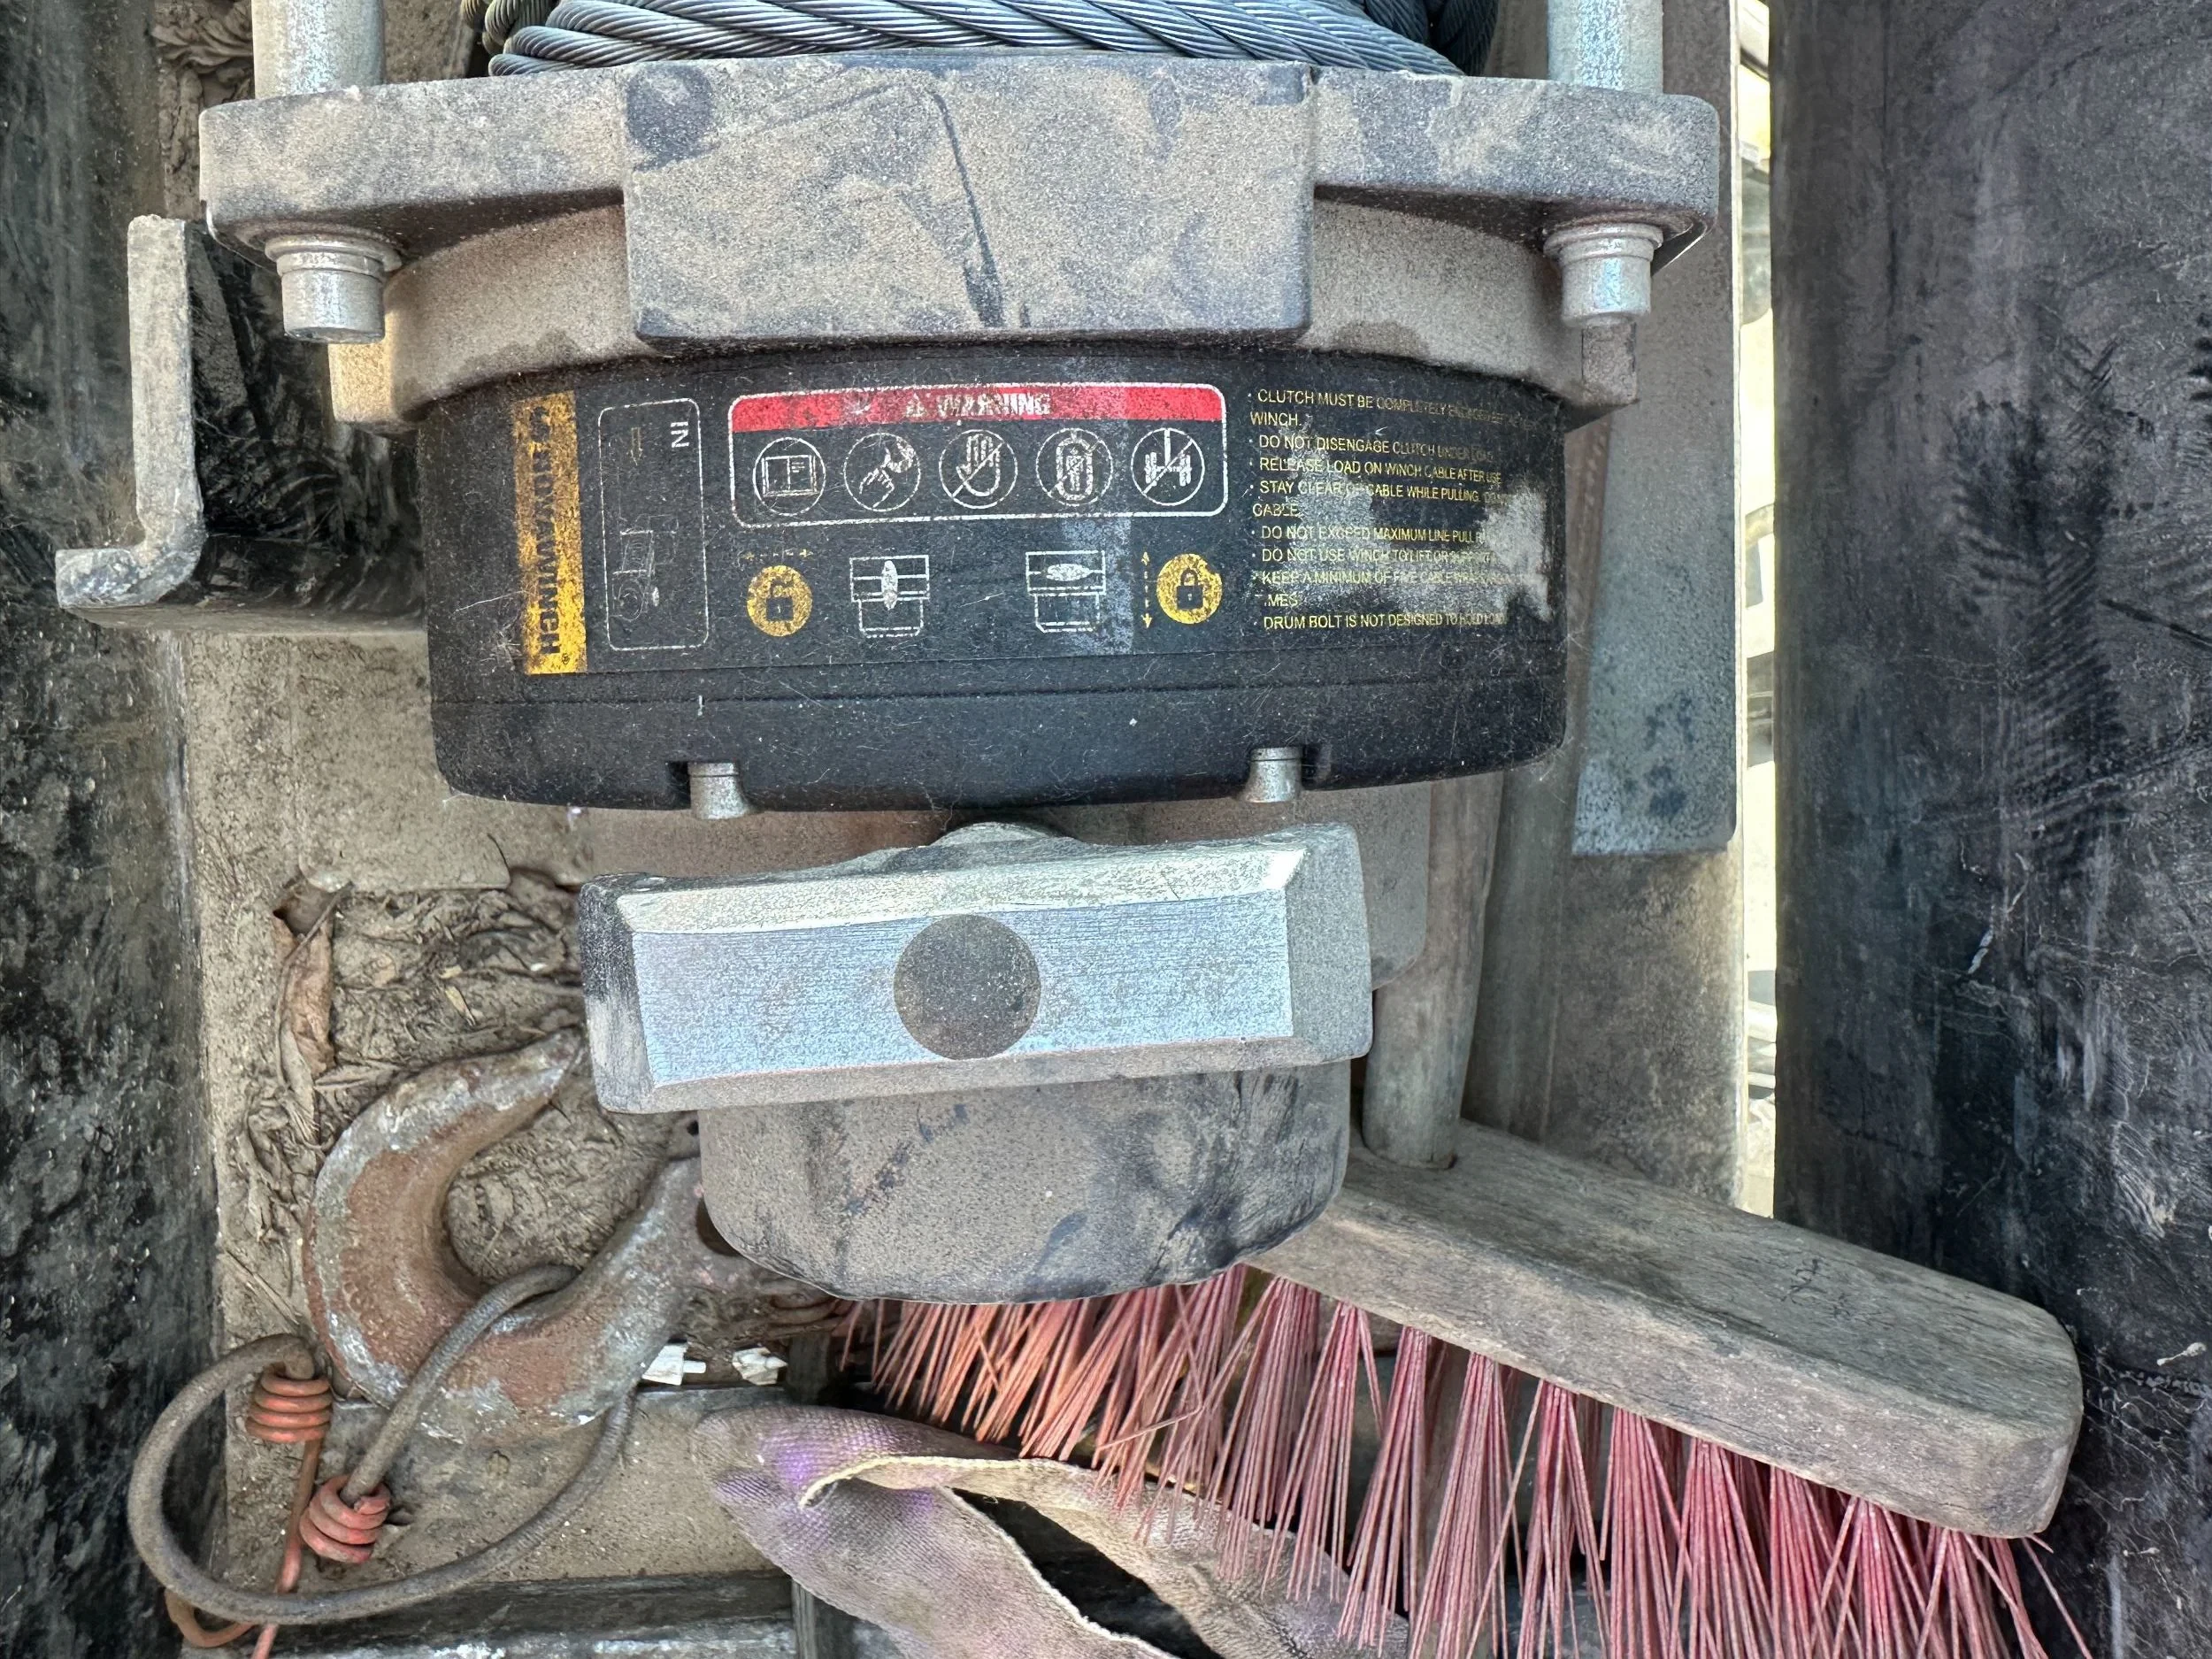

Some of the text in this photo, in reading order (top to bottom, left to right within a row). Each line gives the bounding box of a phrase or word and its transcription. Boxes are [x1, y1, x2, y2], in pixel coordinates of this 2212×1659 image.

[937, 393, 1051, 417] WARNING
[1257, 388, 1314, 404] CLUTCH
[1317, 392, 1355, 408] MUST
[1357, 395, 1374, 408] BE
[1249, 411, 1302, 426] WINCH.
[670, 421, 689, 448] IN
[1259, 434, 1280, 448] DO
[1284, 434, 1311, 449] NOT
[1317, 437, 1390, 454] DISENGAGE
[1392, 441, 1435, 457] CLUTCH
[1259, 457, 1325, 472] RELEASE
[1326, 460, 1362, 474] LOAD
[1363, 461, 1382, 475] ON
[1385, 462, 1421, 478] WINCH
[1424, 465, 1457, 480] CABLE
[1457, 468, 1485, 483] AFTER
[1259, 480, 1294, 495] STAY
[1298, 480, 1344, 495] CLEAR
[1366, 483, 1403, 498] CABLE
[1407, 485, 1440, 500] WHILE
[1261, 526, 1283, 539] DO
[1286, 525, 1315, 540] NOT
[1319, 526, 1371, 541] EXCEED
[1373, 526, 1427, 541] MAXIMUM
[1428, 529, 1450, 542] LINE
[1452, 530, 1476, 543] PULL
[1262, 548, 1284, 563] DO
[1286, 548, 1316, 563] NOT
[1318, 549, 1346, 563] USE
[1262, 570, 1300, 586] KEEP
[1302, 571, 1312, 585] A
[1314, 570, 1371, 585] MINIMUM
[1373, 571, 1391, 586] OF
[1263, 616, 1305, 630] DRUM
[1309, 615, 1343, 629] BOLT
[1345, 615, 1357, 628] IS
[1360, 614, 1386, 628] NOT
[1388, 612, 1443, 627] DESIGNED
[1445, 612, 1458, 626] TO
